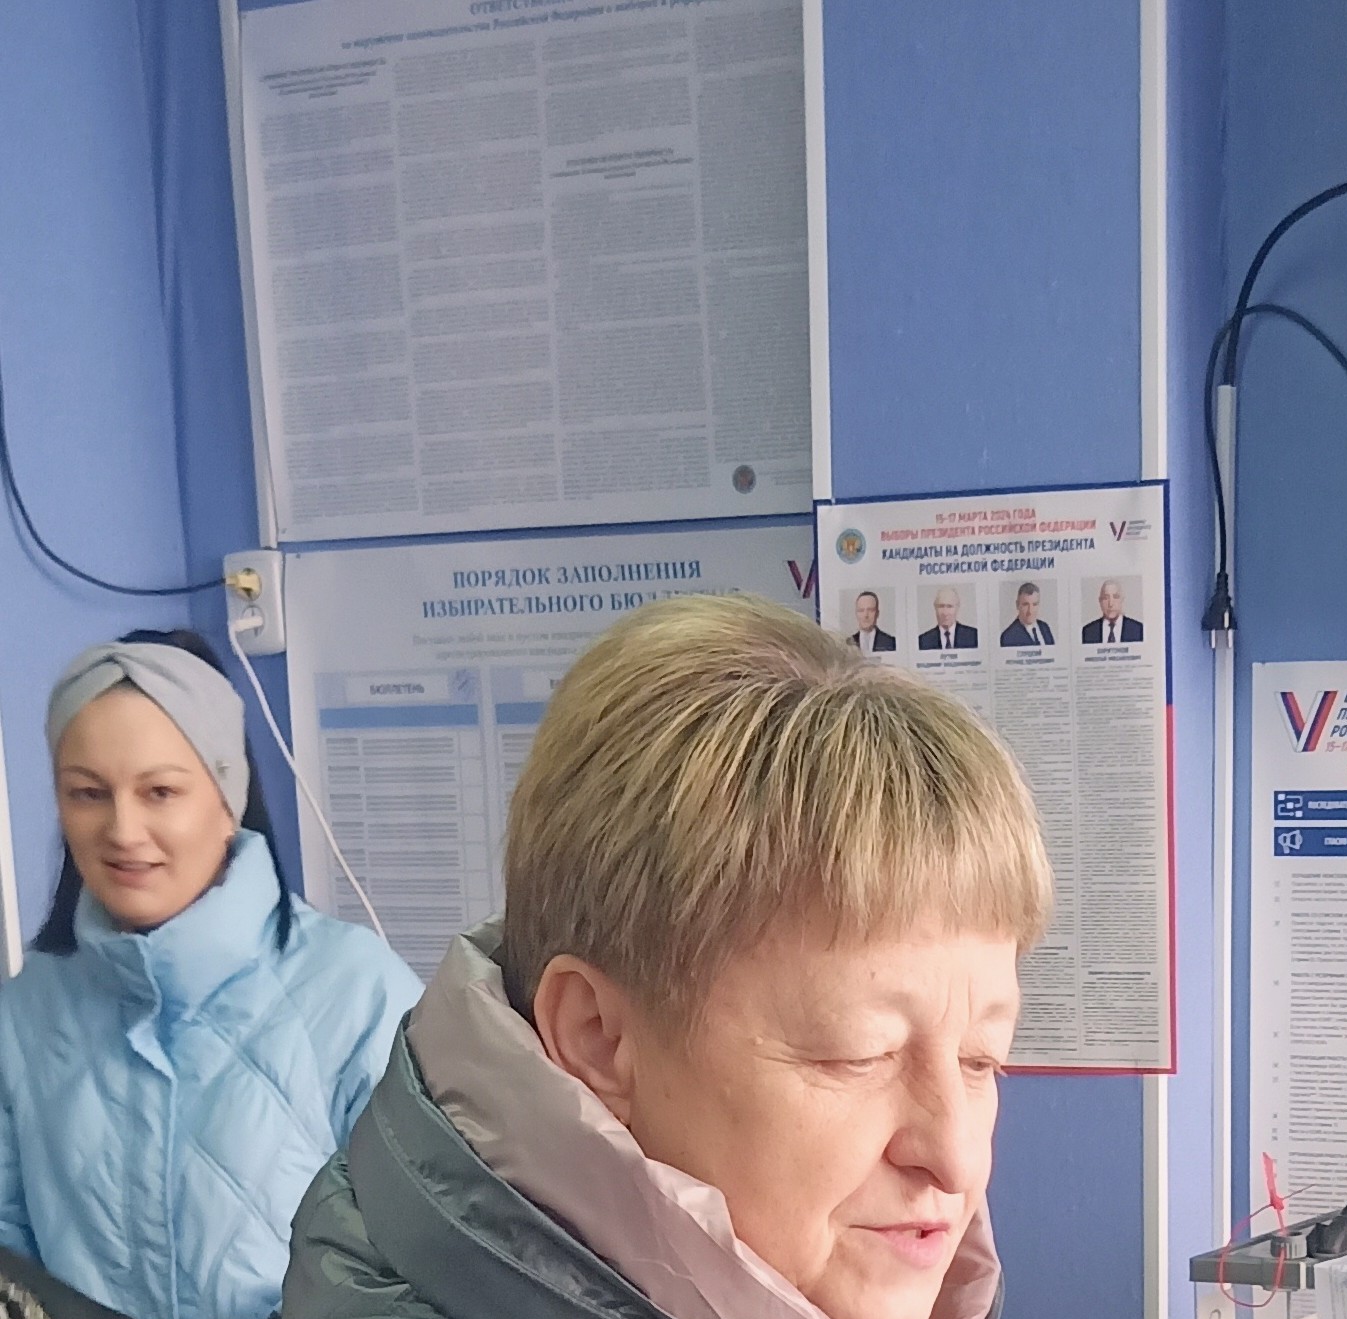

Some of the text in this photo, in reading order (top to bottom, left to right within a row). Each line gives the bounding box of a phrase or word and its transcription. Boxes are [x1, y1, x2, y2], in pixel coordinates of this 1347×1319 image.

[1013, 508, 1036, 520] ГОДА
[881, 519, 1097, 541] ВЫБОРЫ ПРЕЗИДЕНТА РОССИЙСКОЙ ФЕДЕРАЦИИ
[882, 537, 1095, 560] КАНДИДАТЫ НА ДОЛЖНОСТЬ ПРЕЗИДЕНТА
[453, 560, 702, 589] ПОРЯДОК ЗАПОЛНЕНИЯ
[919, 556, 1055, 575] РОССИЙСКОЙ ФЕДЕРАЦИИ
[422, 594, 603, 618] ИЗБИРАТЕЛЬНОГО
